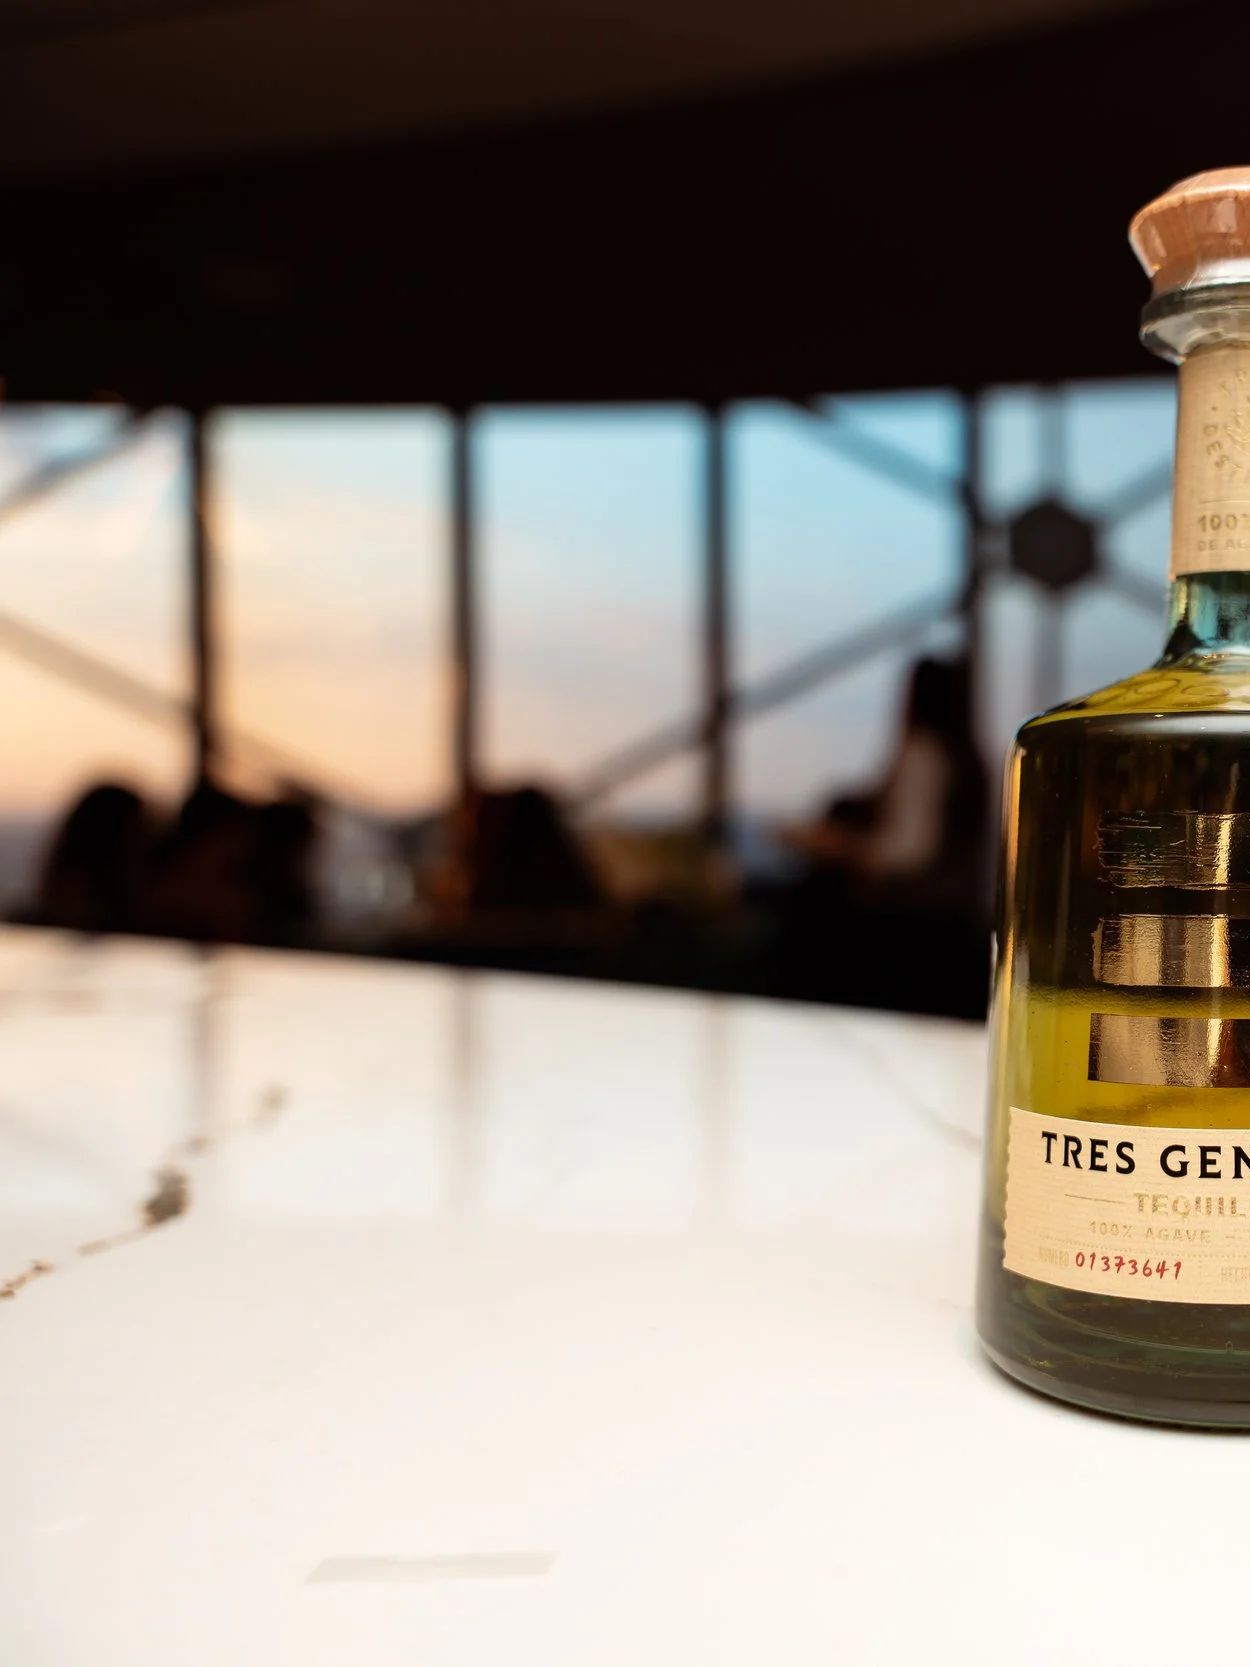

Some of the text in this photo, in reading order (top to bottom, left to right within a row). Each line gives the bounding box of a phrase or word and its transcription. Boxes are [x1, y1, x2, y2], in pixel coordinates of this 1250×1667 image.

[1041, 1130, 1136, 1175] TRES
[1089, 1220, 1134, 1240] 100%
[1145, 1228, 1211, 1244] AGAVE
[1075, 1251, 1182, 1280] 01373641
